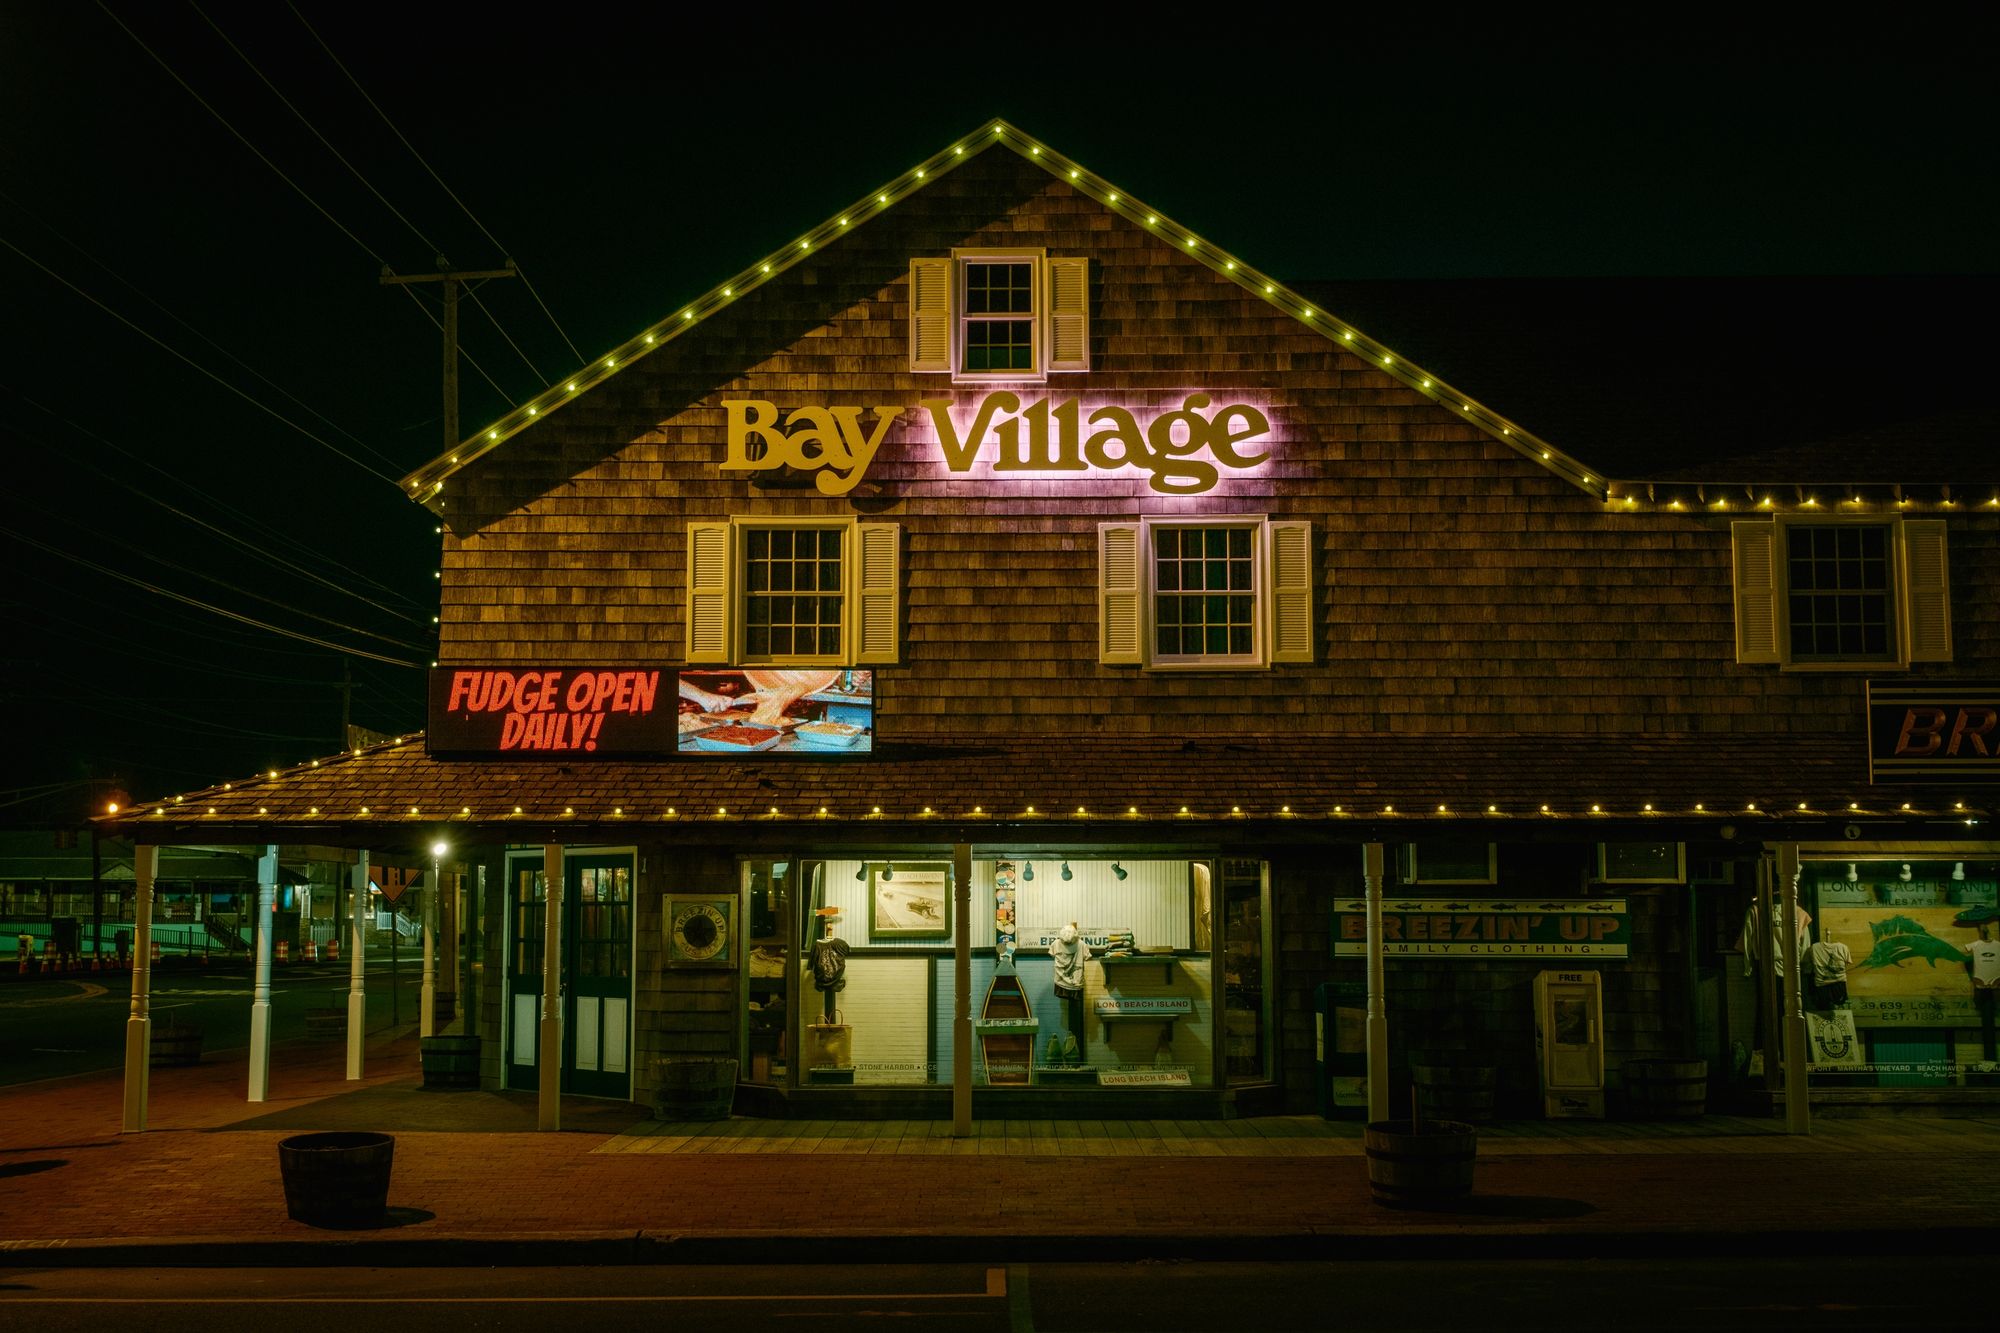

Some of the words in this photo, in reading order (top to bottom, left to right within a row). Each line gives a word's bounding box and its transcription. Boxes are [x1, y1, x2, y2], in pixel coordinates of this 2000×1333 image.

[719, 399, 905, 495] Bay
[920, 391, 1271, 495] Village
[447, 671, 562, 714] FUDGE
[566, 671, 660, 716] OPEN
[500, 712, 605, 751] DAILY!
[1894, 706, 2000, 757] BR
[1822, 881, 1866, 892] LONG
[1934, 881, 1992, 892] ISLAND
[1340, 915, 1541, 939] BREEZIN'
[1559, 916, 1619, 940] UP
[1382, 944, 1450, 953] AMILY
[1470, 945, 1590, 953] CLOTHING
[1559, 974, 1583, 982] FREE
[1876, 1064, 1910, 1072] VINEYARD
[1917, 1064, 1942, 1072] BEACH
